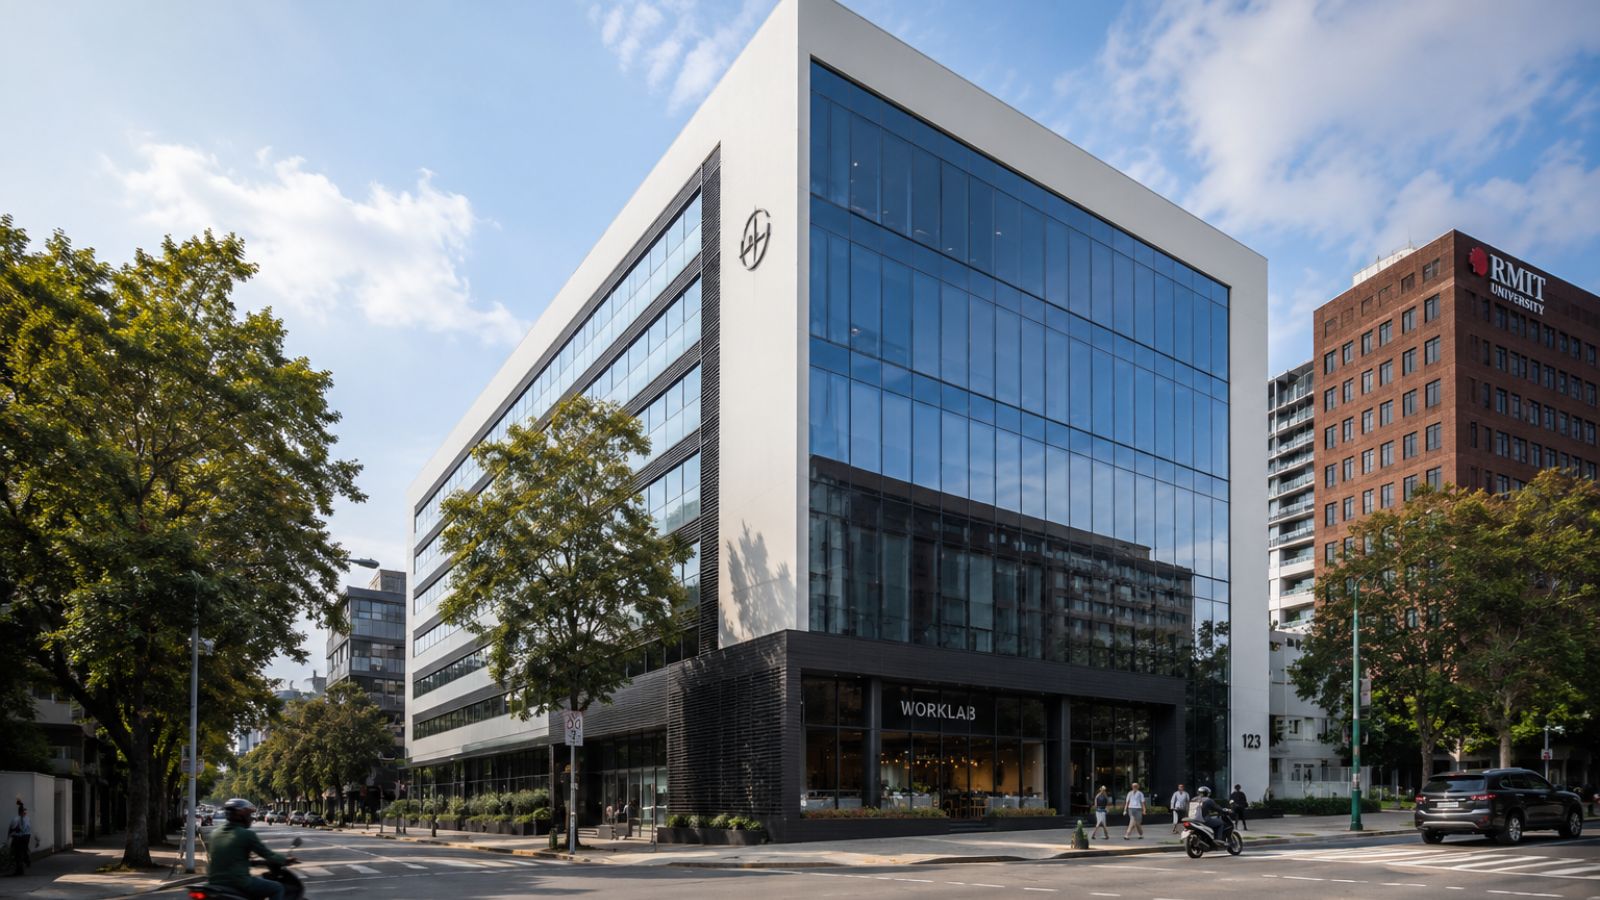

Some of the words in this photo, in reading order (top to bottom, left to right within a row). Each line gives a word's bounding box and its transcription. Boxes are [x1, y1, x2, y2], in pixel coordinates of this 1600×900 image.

[1490, 253, 1546, 302] RMIT
[1491, 282, 1545, 316] UNIVERSITY
[900, 700, 976, 720] WORKLAB
[1242, 733, 1261, 749] 123
